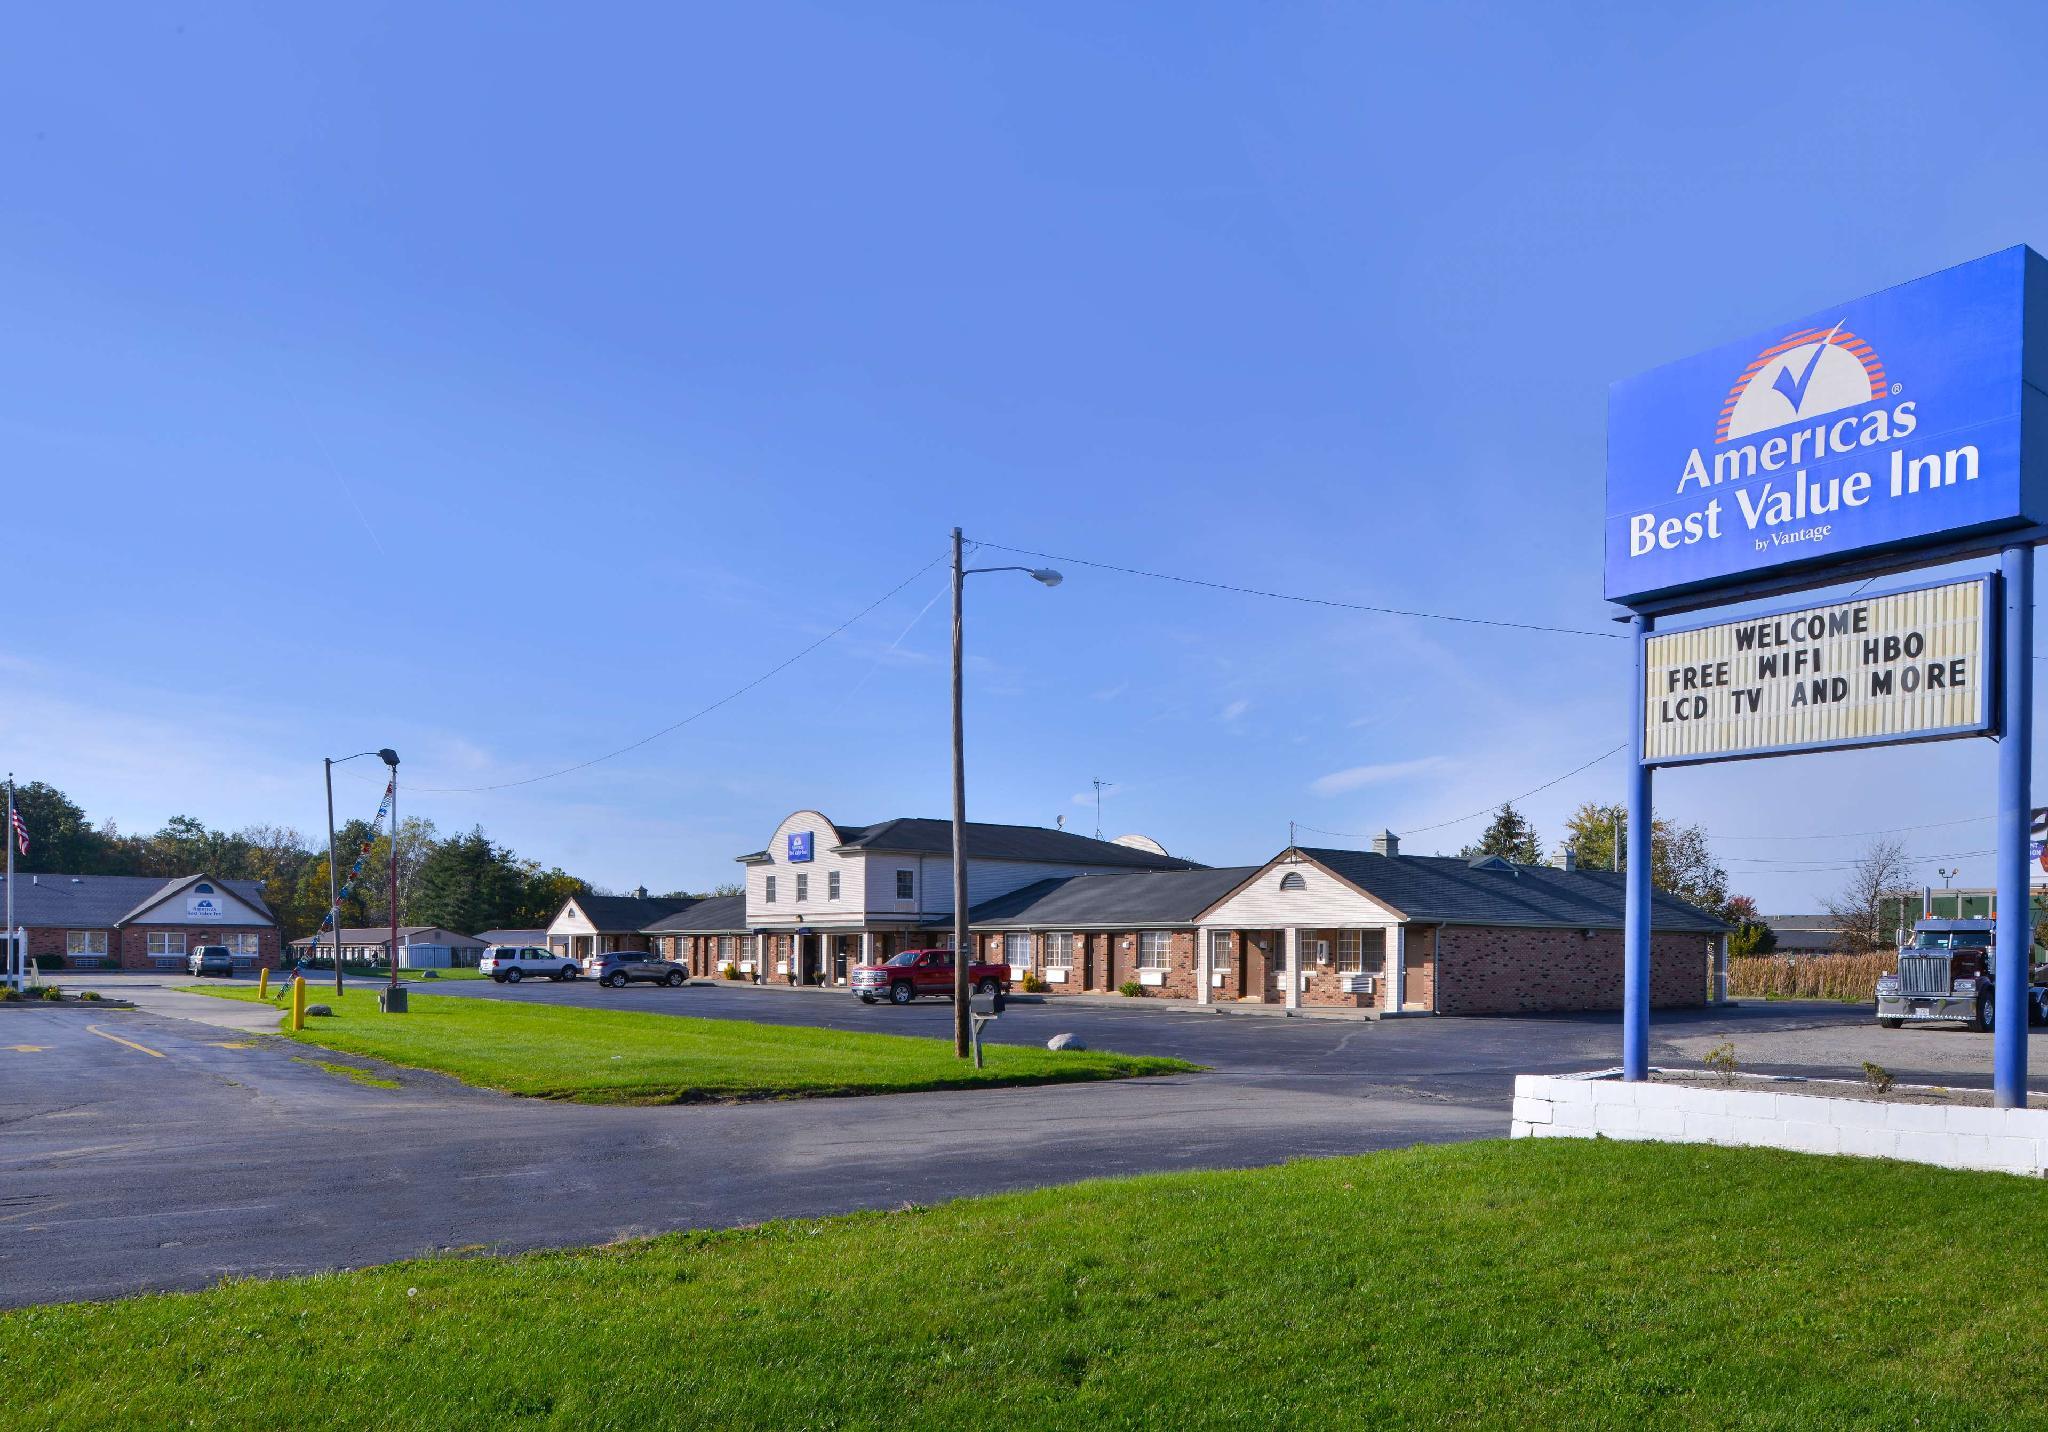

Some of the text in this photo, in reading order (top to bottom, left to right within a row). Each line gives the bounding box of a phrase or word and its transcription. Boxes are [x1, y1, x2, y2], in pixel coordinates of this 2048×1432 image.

[1676, 401, 1917, 494] Americas
[1630, 445, 1979, 557] Best Value Inn
[1754, 524, 1833, 553] by Vantage
[1735, 607, 1868, 652] WELCOME
[1661, 658, 1966, 723] LCD TV AND MORE
[1668, 632, 1924, 694] FREE WIFI HBO
